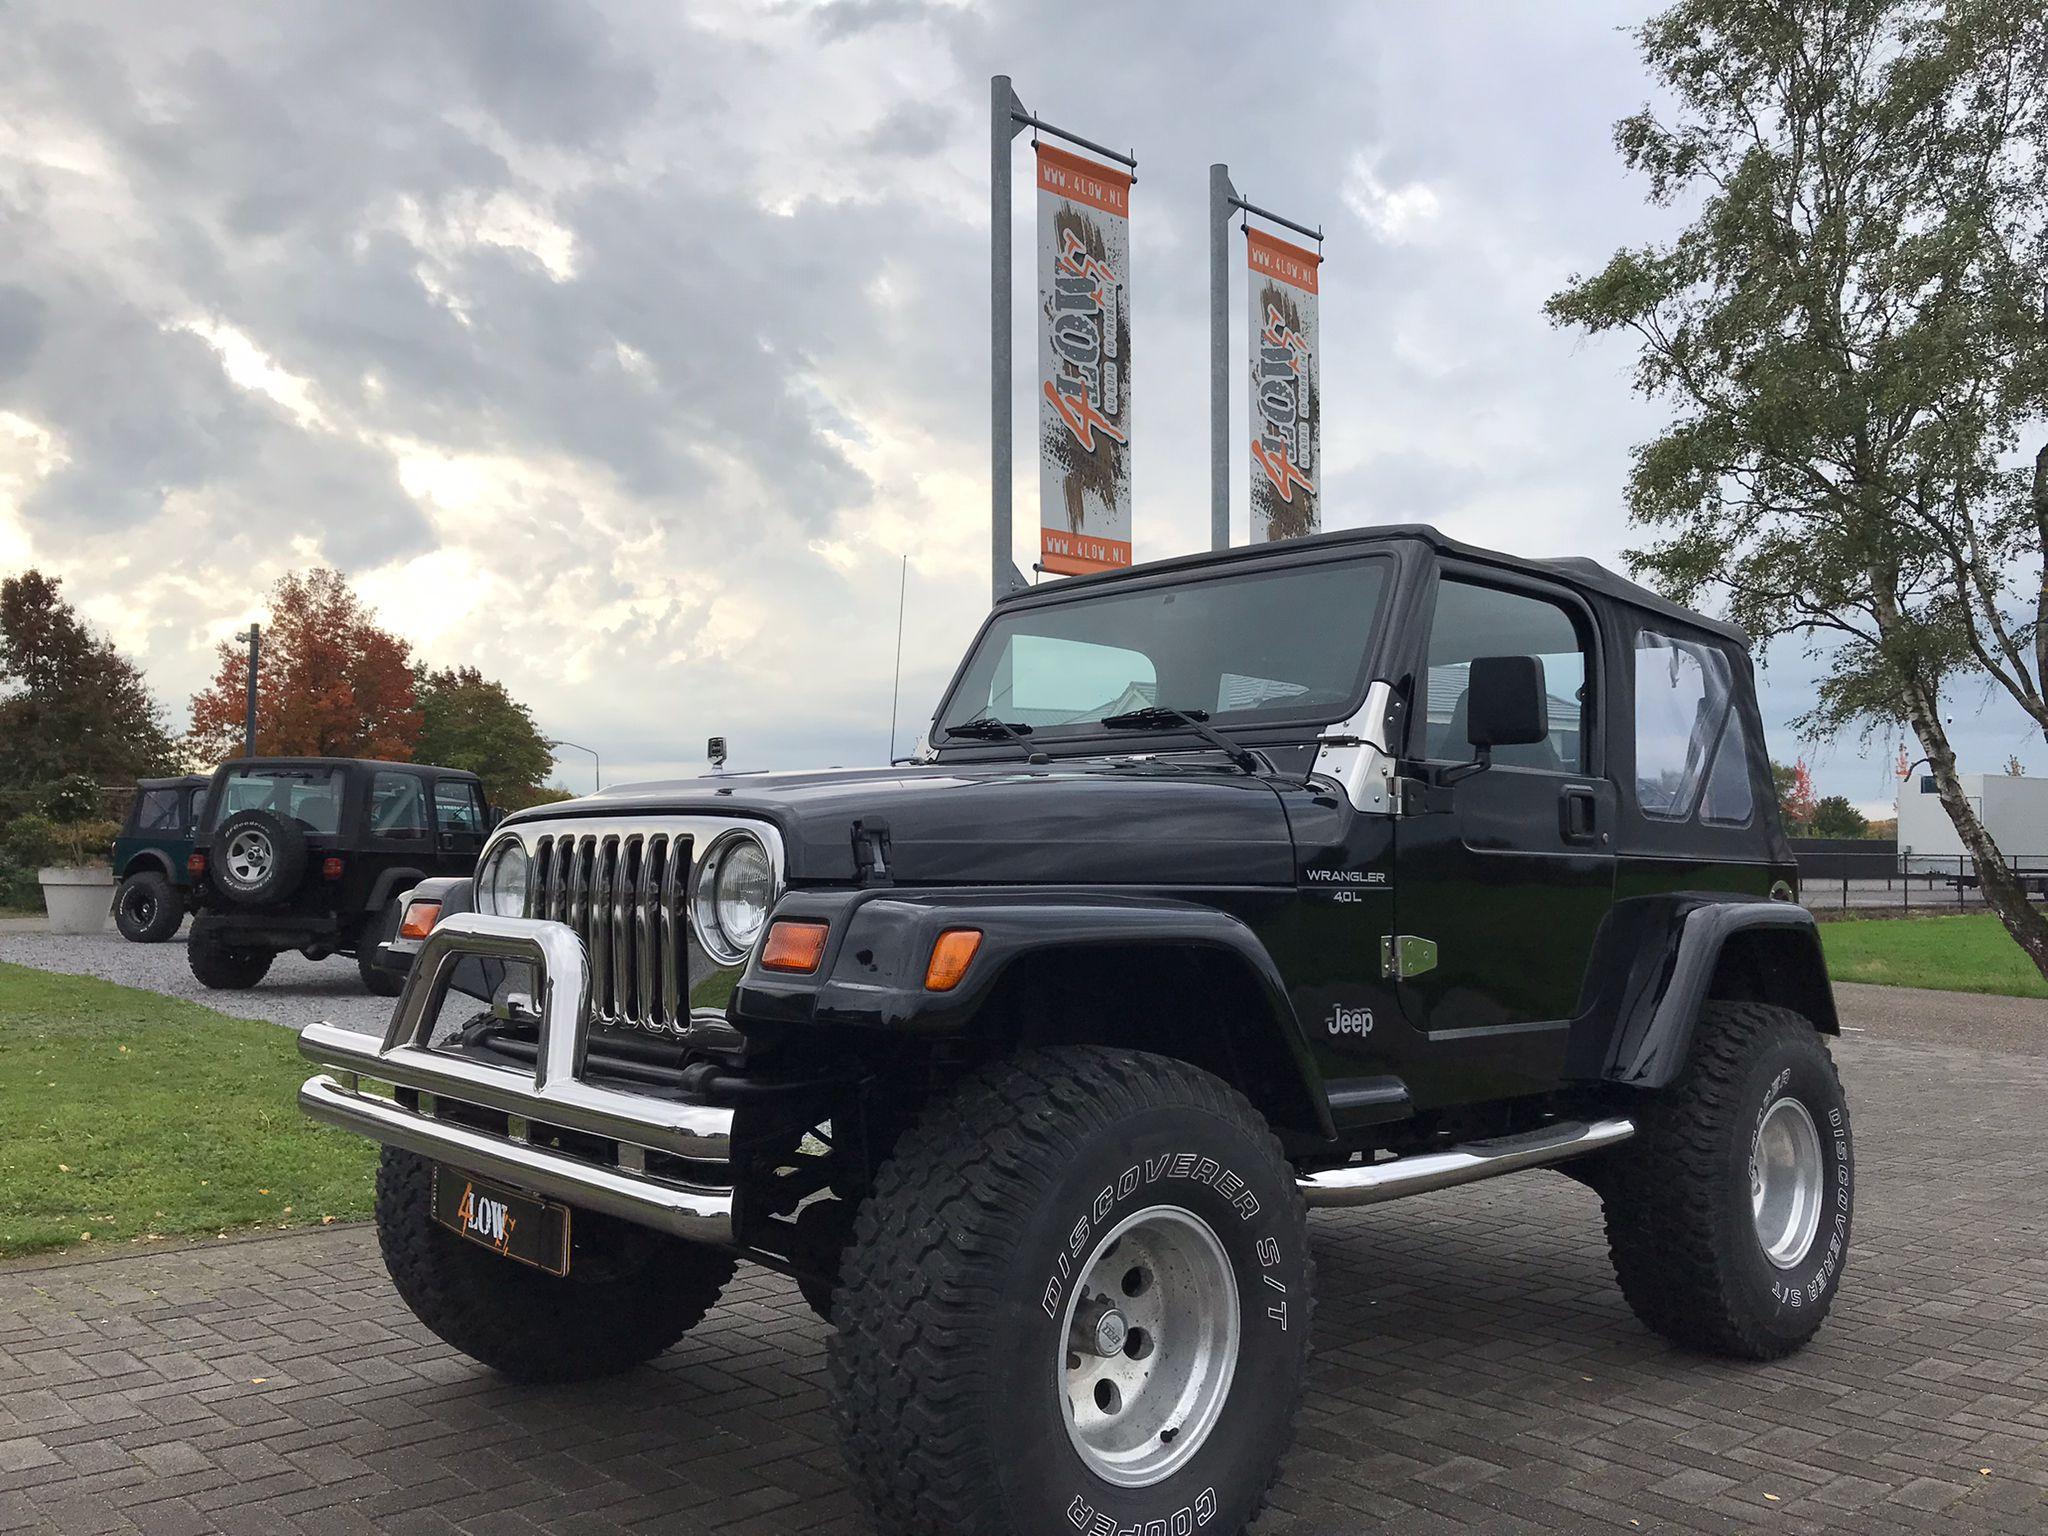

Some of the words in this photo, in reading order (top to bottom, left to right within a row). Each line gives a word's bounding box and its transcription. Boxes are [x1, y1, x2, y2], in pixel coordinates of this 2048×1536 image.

[1043, 164, 1123, 208] WWW.4LOW.NL
[1252, 247, 1313, 285] WWW.4LOW.NL
[1107, 341, 1115, 355] NO
[1107, 365, 1115, 393] ROAD
[1107, 398, 1115, 411] NO
[1301, 453, 1308, 466] NO
[1046, 536, 1126, 564] WWW.4LOW.NL
[1306, 869, 1386, 883] WRANGLER
[1326, 1004, 1374, 1037] Jeep
[1808, 1107, 1848, 1302] DISCOVERER
[1041, 1152, 1260, 1319] DISCOVERER
[1256, 1236, 1287, 1331] S/T
[1772, 1281, 1802, 1307] S/T
